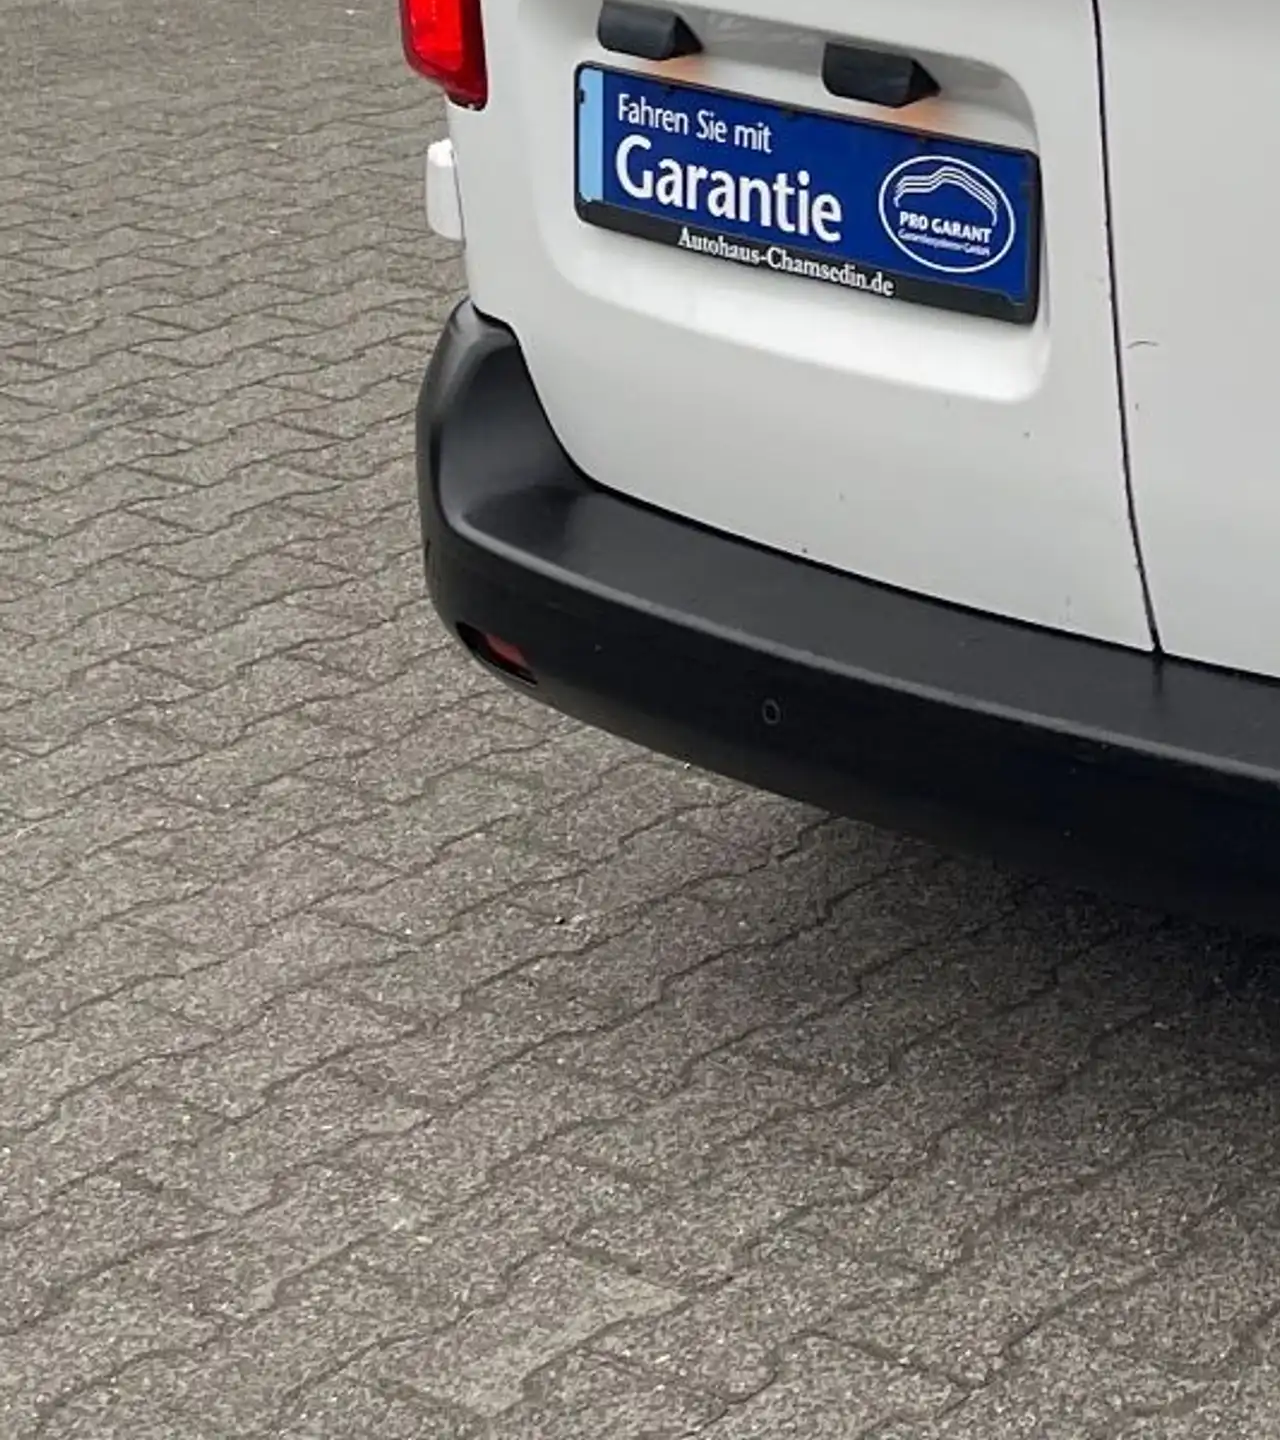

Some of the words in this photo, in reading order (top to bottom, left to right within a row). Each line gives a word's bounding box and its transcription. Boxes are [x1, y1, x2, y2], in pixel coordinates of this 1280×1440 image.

[617, 93, 689, 137] Fahren
[696, 110, 727, 144] Sie
[734, 120, 772, 155] mit
[615, 134, 843, 243] Garantie
[900, 211, 929, 231] PRO
[931, 218, 992, 244] GARANT
[677, 226, 895, 297] Autohaus-Chamsedin.de
